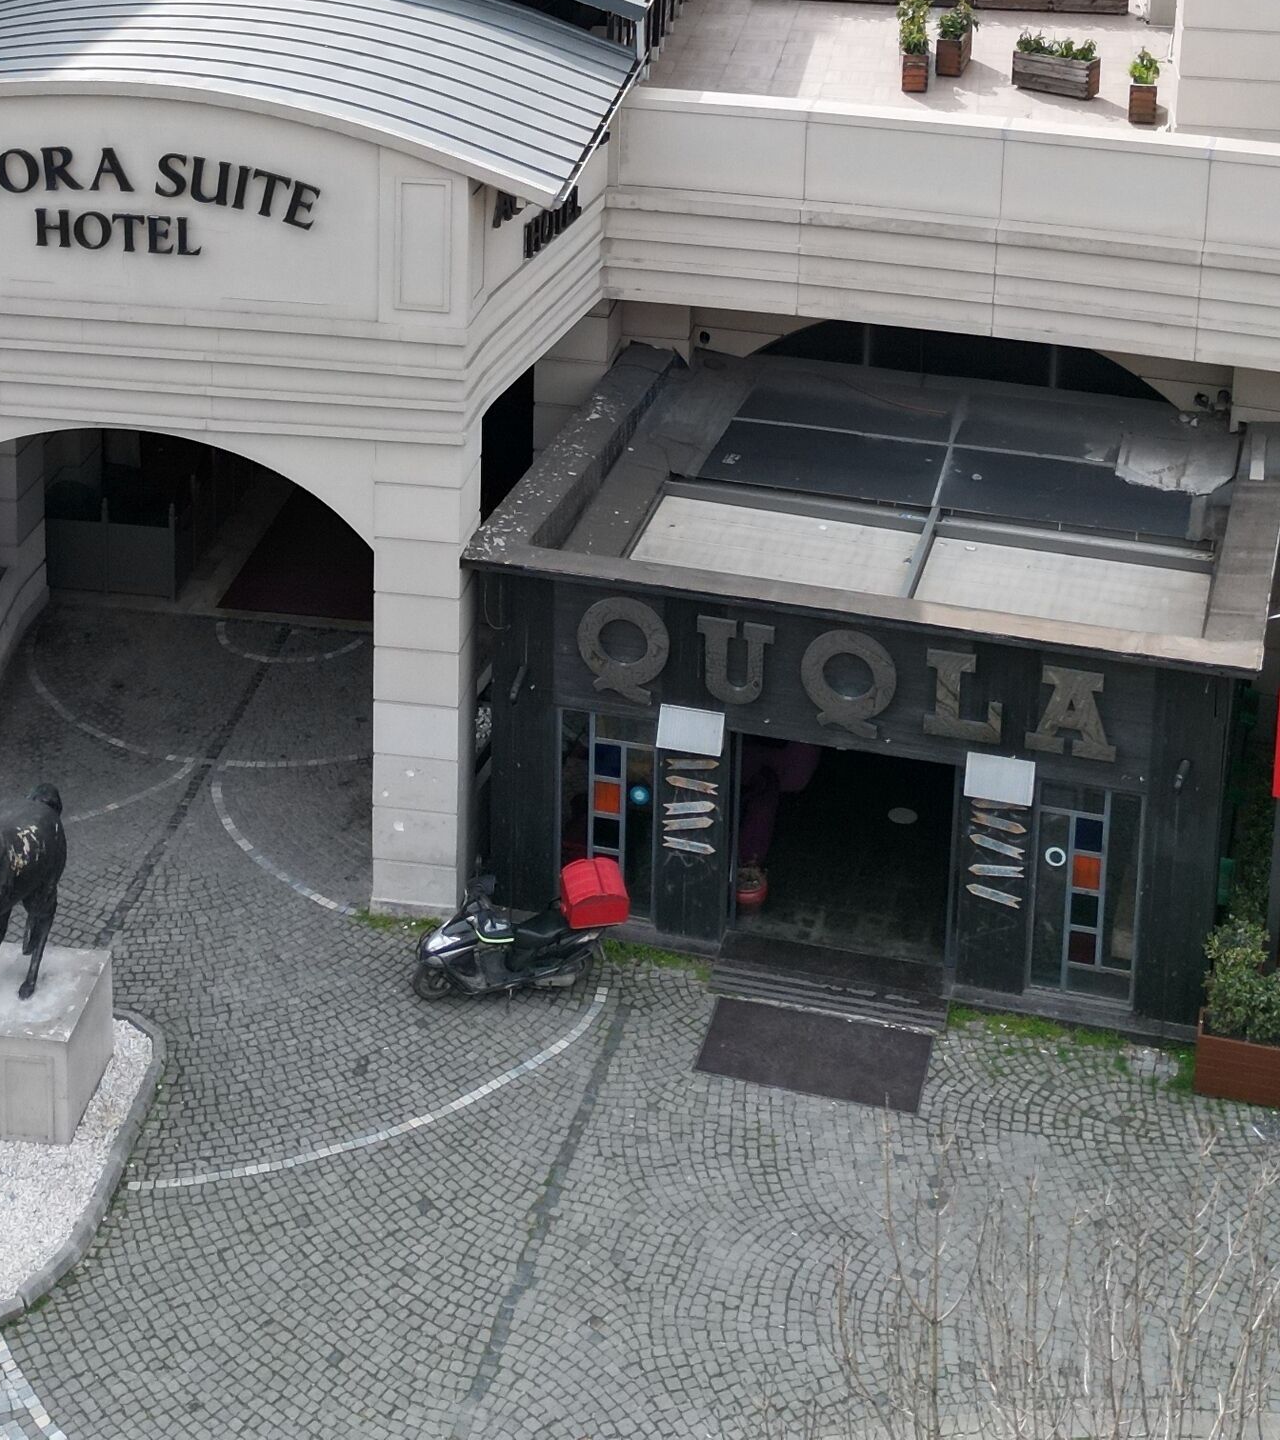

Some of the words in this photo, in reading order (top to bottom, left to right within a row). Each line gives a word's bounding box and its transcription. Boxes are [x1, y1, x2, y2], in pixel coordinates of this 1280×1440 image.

[155, 152, 321, 230] SUITE
[35, 208, 202, 256] HOTEL
[577, 596, 1117, 762] QUQLA
